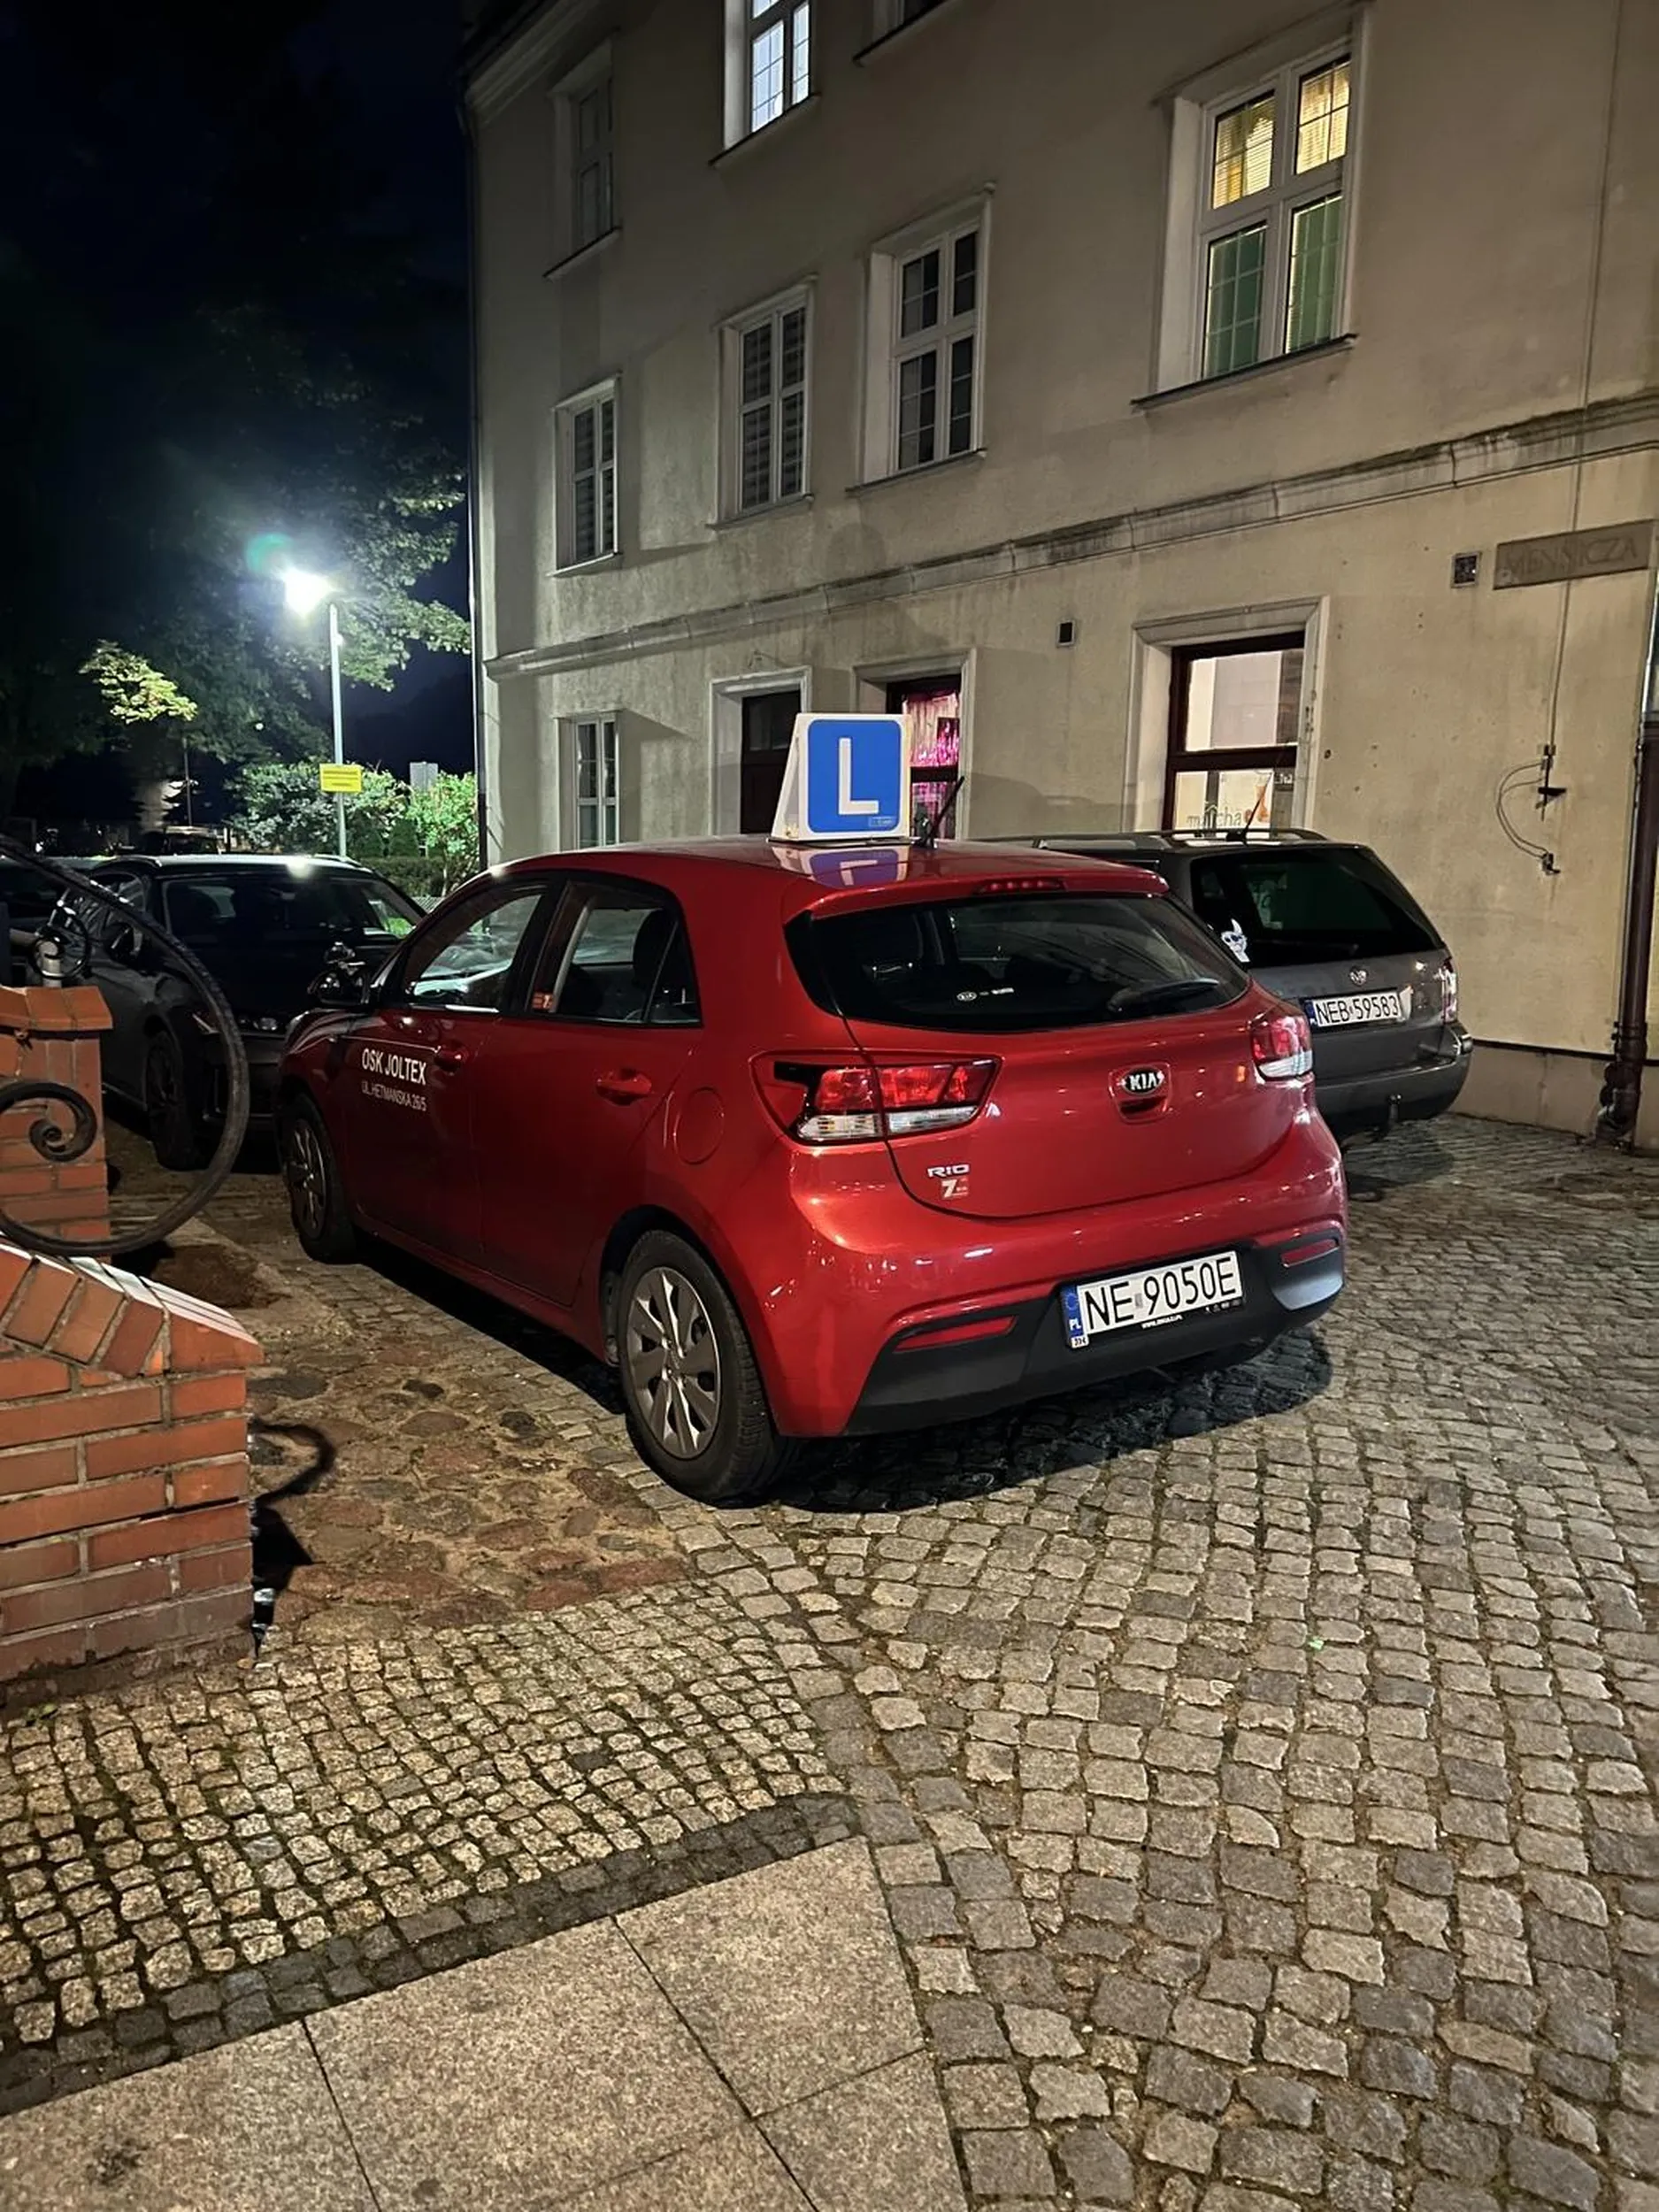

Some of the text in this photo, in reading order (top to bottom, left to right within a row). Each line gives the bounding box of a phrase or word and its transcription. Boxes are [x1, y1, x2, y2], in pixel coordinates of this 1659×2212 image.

[838, 737, 879, 815] L
[1315, 995, 1398, 1025] NEB 59583
[362, 1048, 426, 1086] OSK JOLTEX
[1129, 1071, 1157, 1090] KIA
[926, 1164, 970, 1178] RIO
[1084, 1256, 1236, 1330] NE 9050E
[1069, 1318, 1081, 1331] PL
